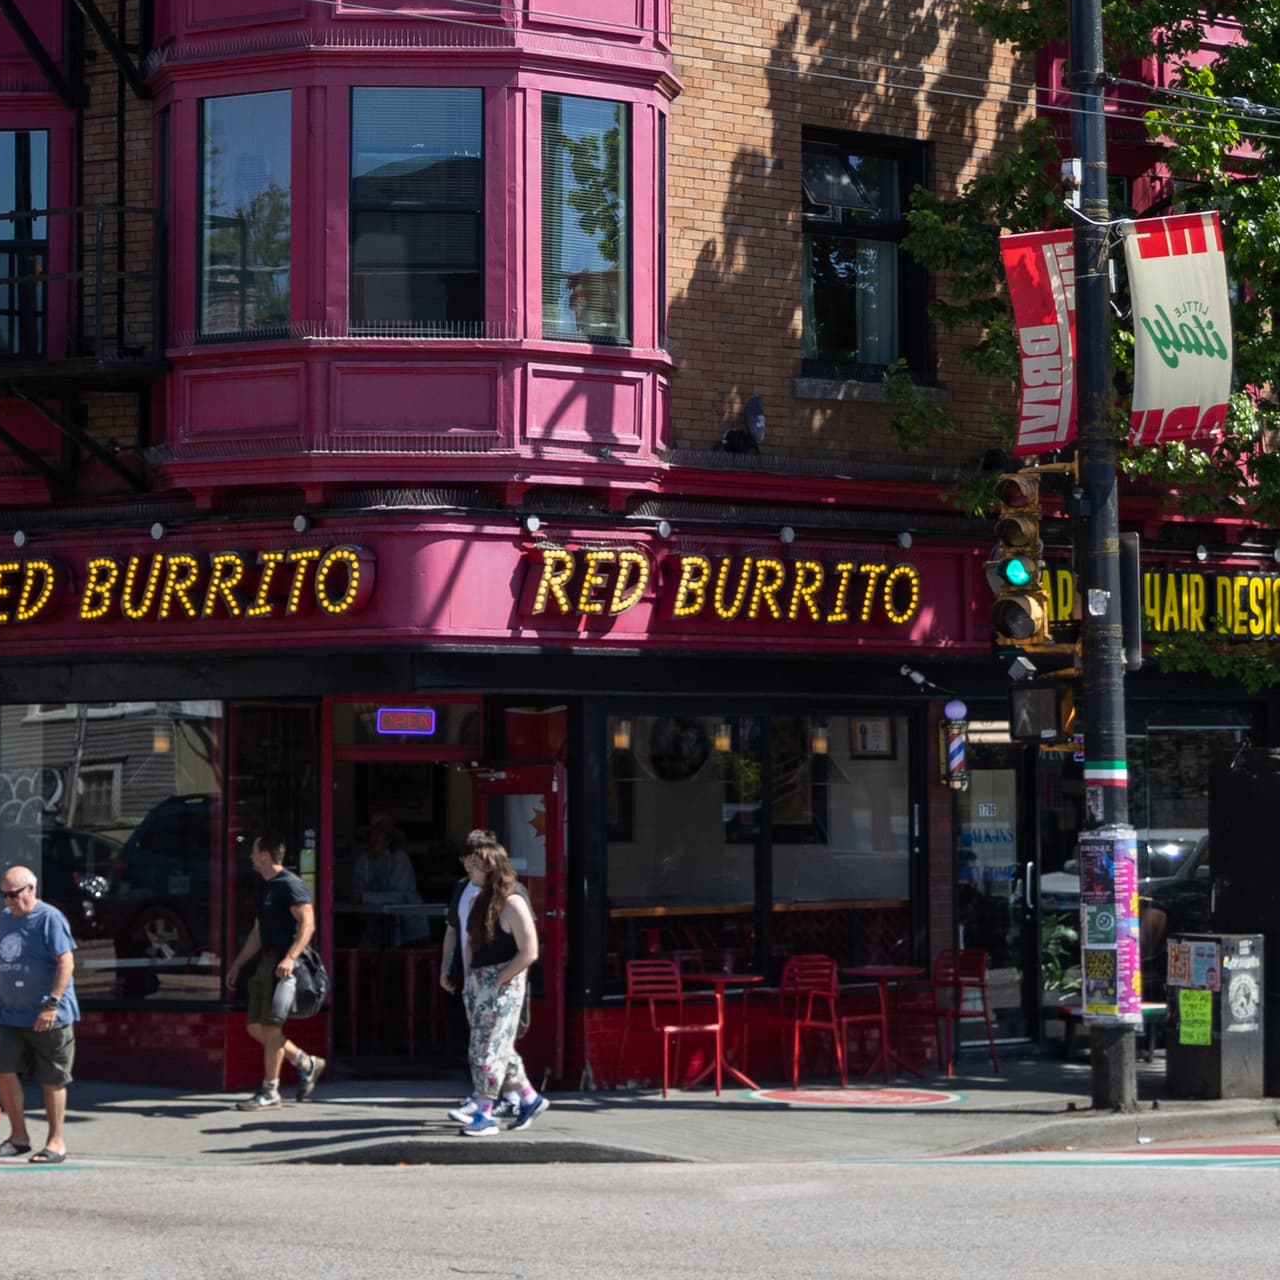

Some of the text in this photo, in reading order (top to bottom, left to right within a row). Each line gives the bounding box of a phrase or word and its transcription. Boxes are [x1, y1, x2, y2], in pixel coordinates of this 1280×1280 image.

[79, 545, 362, 620] BURRITO
[532, 548, 921, 624] RED BURRITO
[381, 711, 433, 729] OPEN
